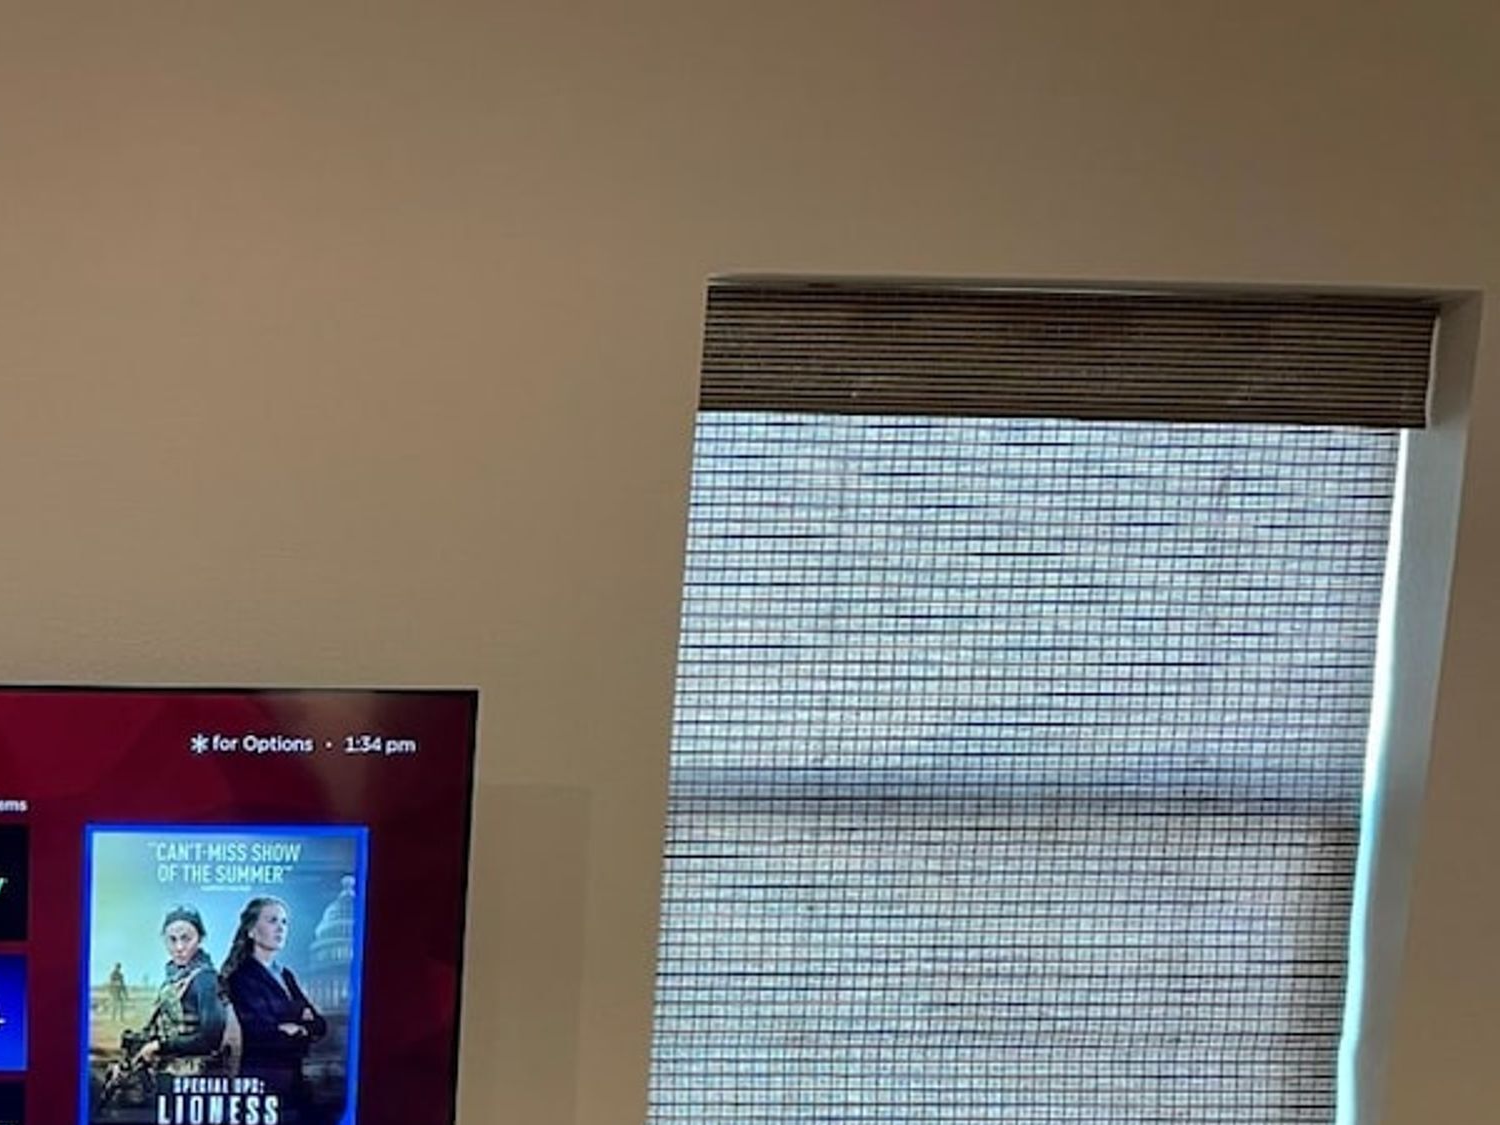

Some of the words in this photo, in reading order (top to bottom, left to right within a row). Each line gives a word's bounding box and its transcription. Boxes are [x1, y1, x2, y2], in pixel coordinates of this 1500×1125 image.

[212, 734, 239, 752] for
[242, 735, 314, 753] Options
[345, 736, 382, 753] 1:34
[385, 739, 417, 755] pm
[251, 843, 301, 862] SHOW
[156, 864, 179, 882] OF
[181, 865, 213, 883] THE
[157, 1094, 280, 1125] LIONESS
